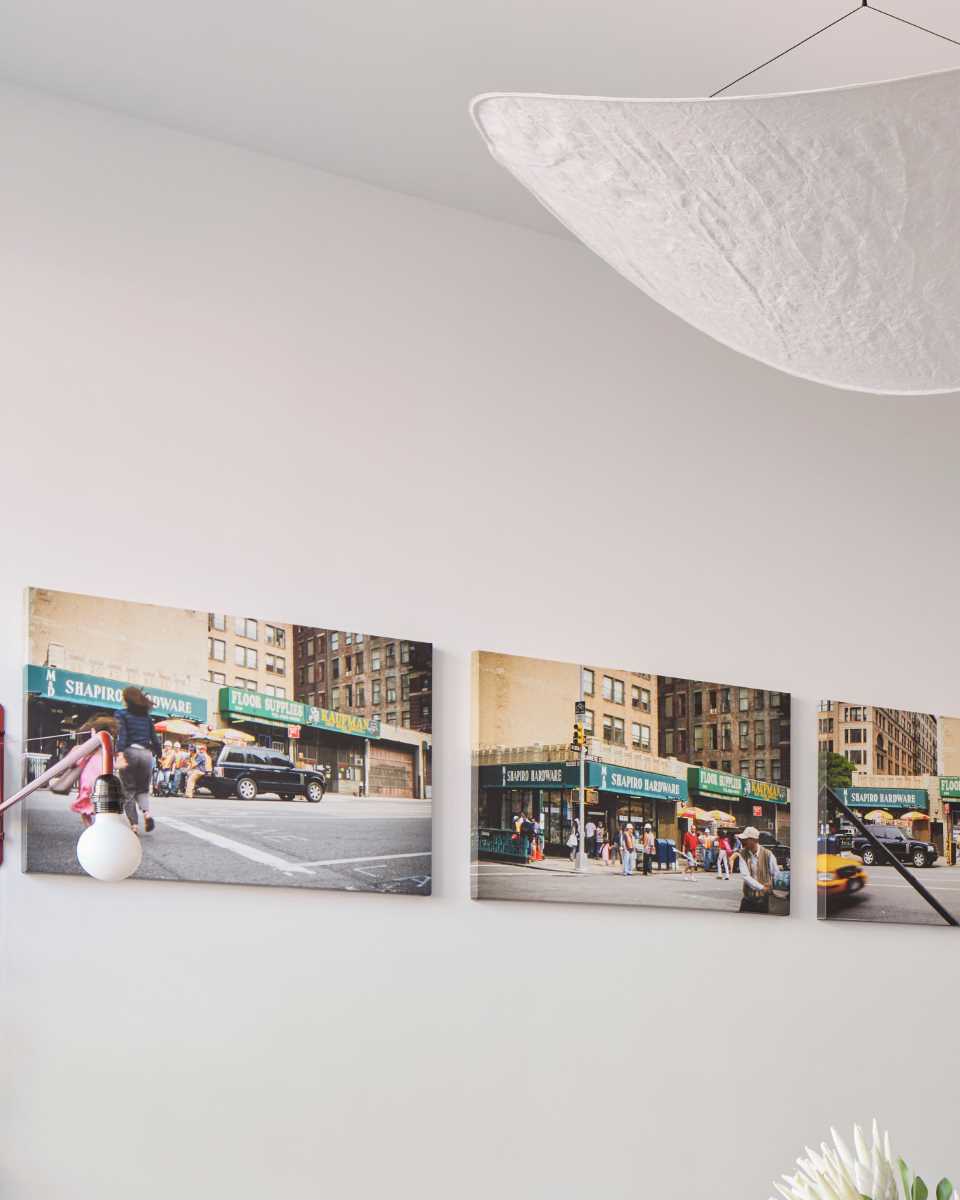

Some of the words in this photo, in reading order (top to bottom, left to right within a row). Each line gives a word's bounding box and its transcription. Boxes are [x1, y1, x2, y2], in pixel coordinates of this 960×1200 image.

[64, 679, 122, 702] SHAPIRO
[231, 690, 262, 709] FLOOR
[264, 697, 304, 719] SUPPLIES
[506, 769, 530, 782] SHAPIRO
[530, 769, 562, 782] HARDWARE
[611, 773, 643, 790] SHAPIRO
[644, 779, 680, 795] HARDWARE
[851, 792, 878, 802] SHAPIRO
[879, 793, 916, 803] HARDWARE
